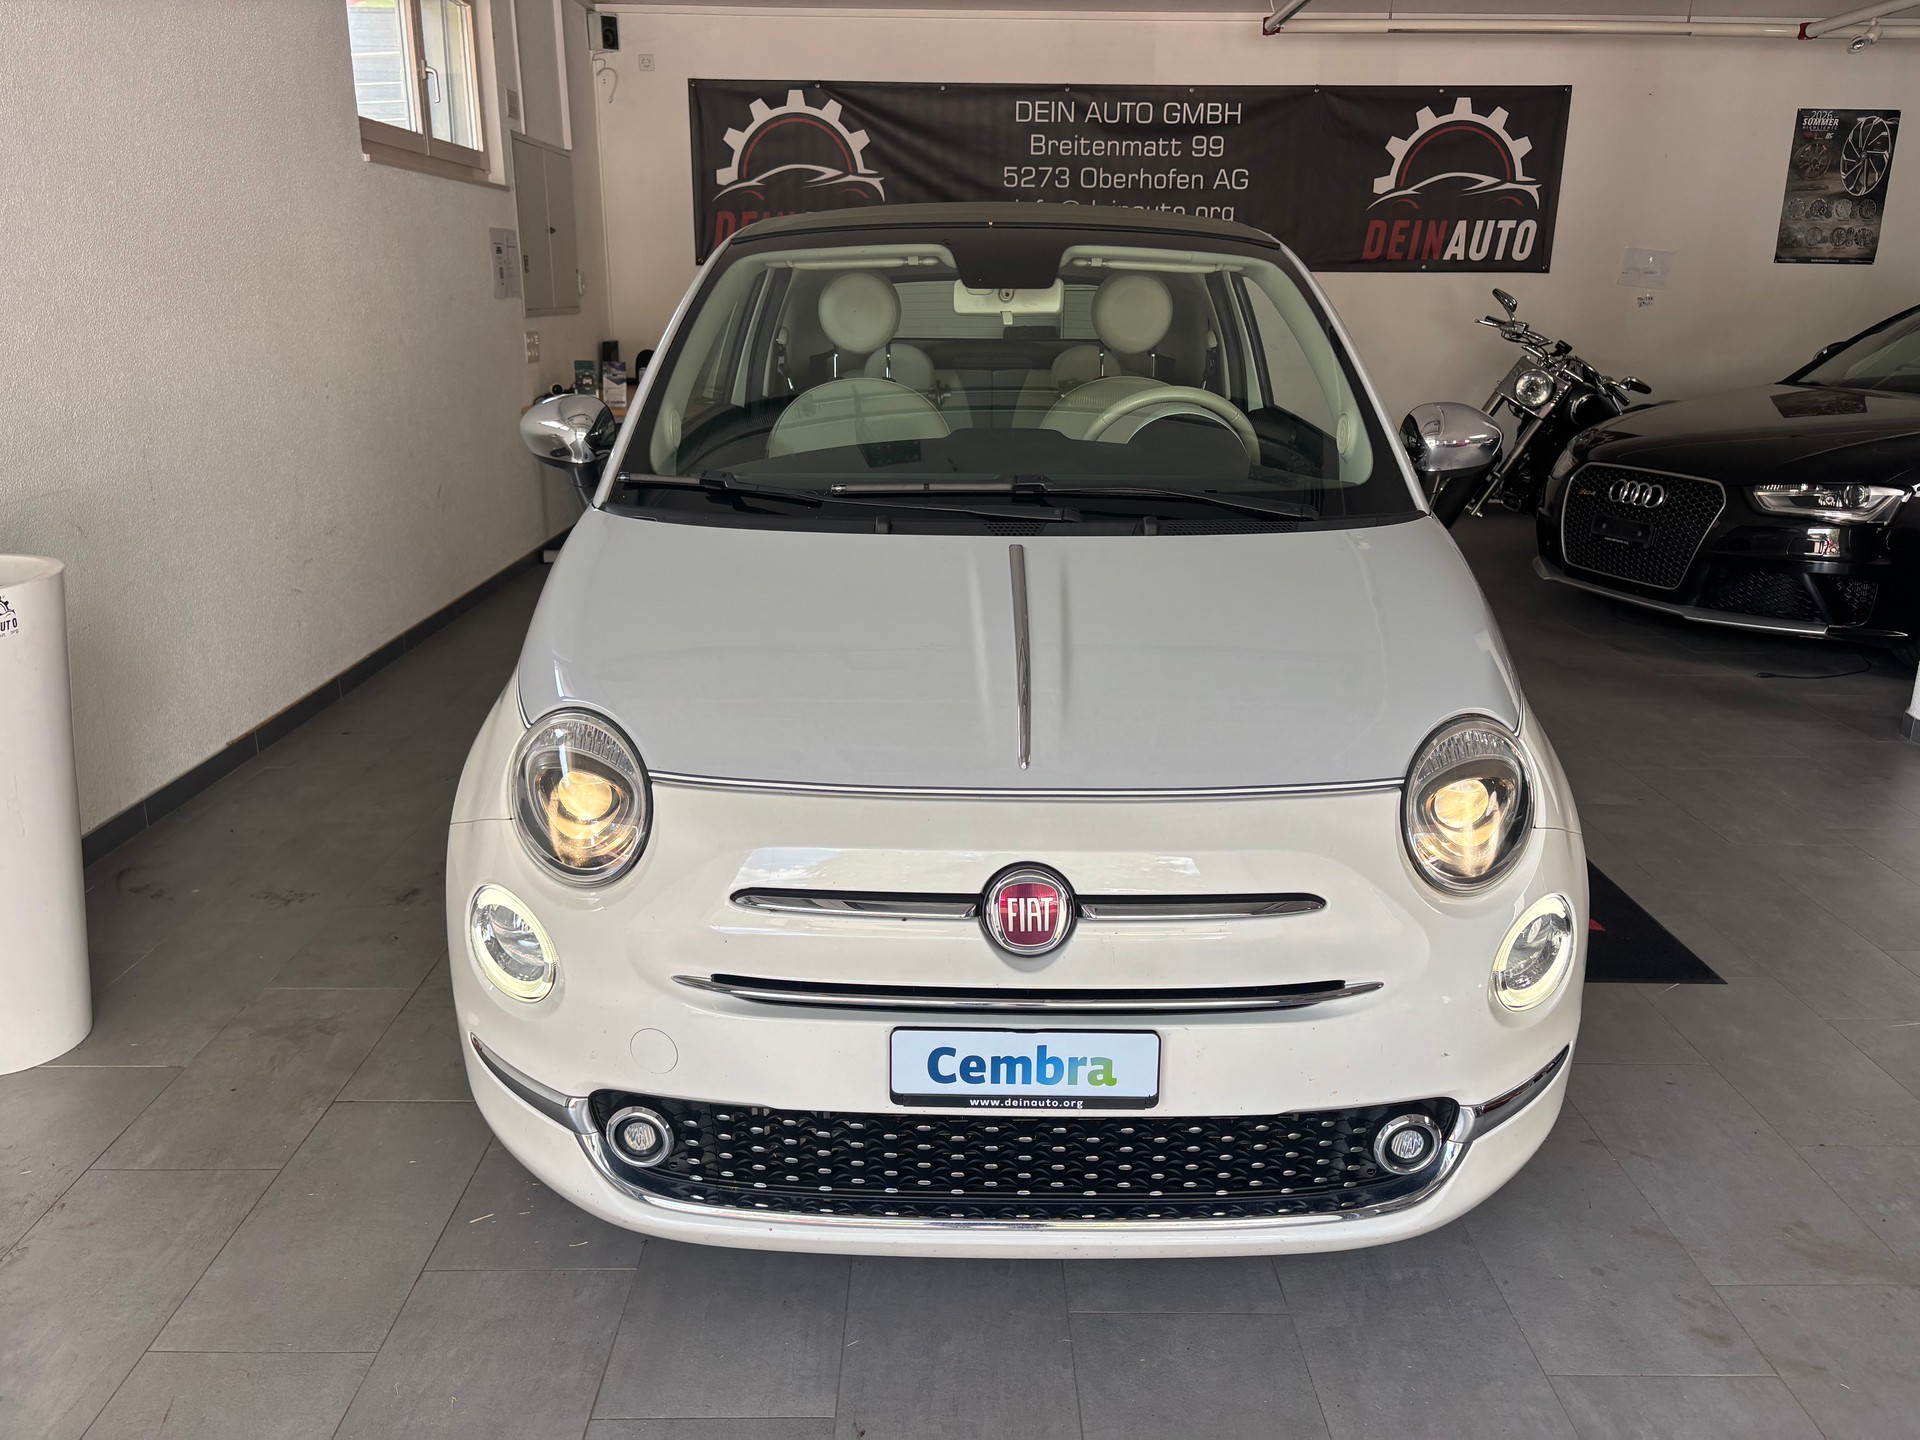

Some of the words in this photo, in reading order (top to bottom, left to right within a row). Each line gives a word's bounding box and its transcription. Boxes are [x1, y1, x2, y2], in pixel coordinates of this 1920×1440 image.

[1015, 100, 1075, 123] DEIN
[1084, 102, 1154, 124] AUTO
[1163, 103, 1242, 125] GMBH
[1802, 118, 1839, 126] SUMMER
[1810, 110, 1833, 119] 2026
[1030, 134, 1182, 157] Breitenmatt
[1191, 135, 1225, 158] 99
[1003, 166, 1070, 188] 5273
[1080, 167, 1204, 190] Oberhofen
[1213, 168, 1249, 190] AG
[1007, 897, 1054, 932] FIAT
[927, 1044, 1118, 1087] Cembra
[969, 1097, 1084, 1110] www.deinauto.org
